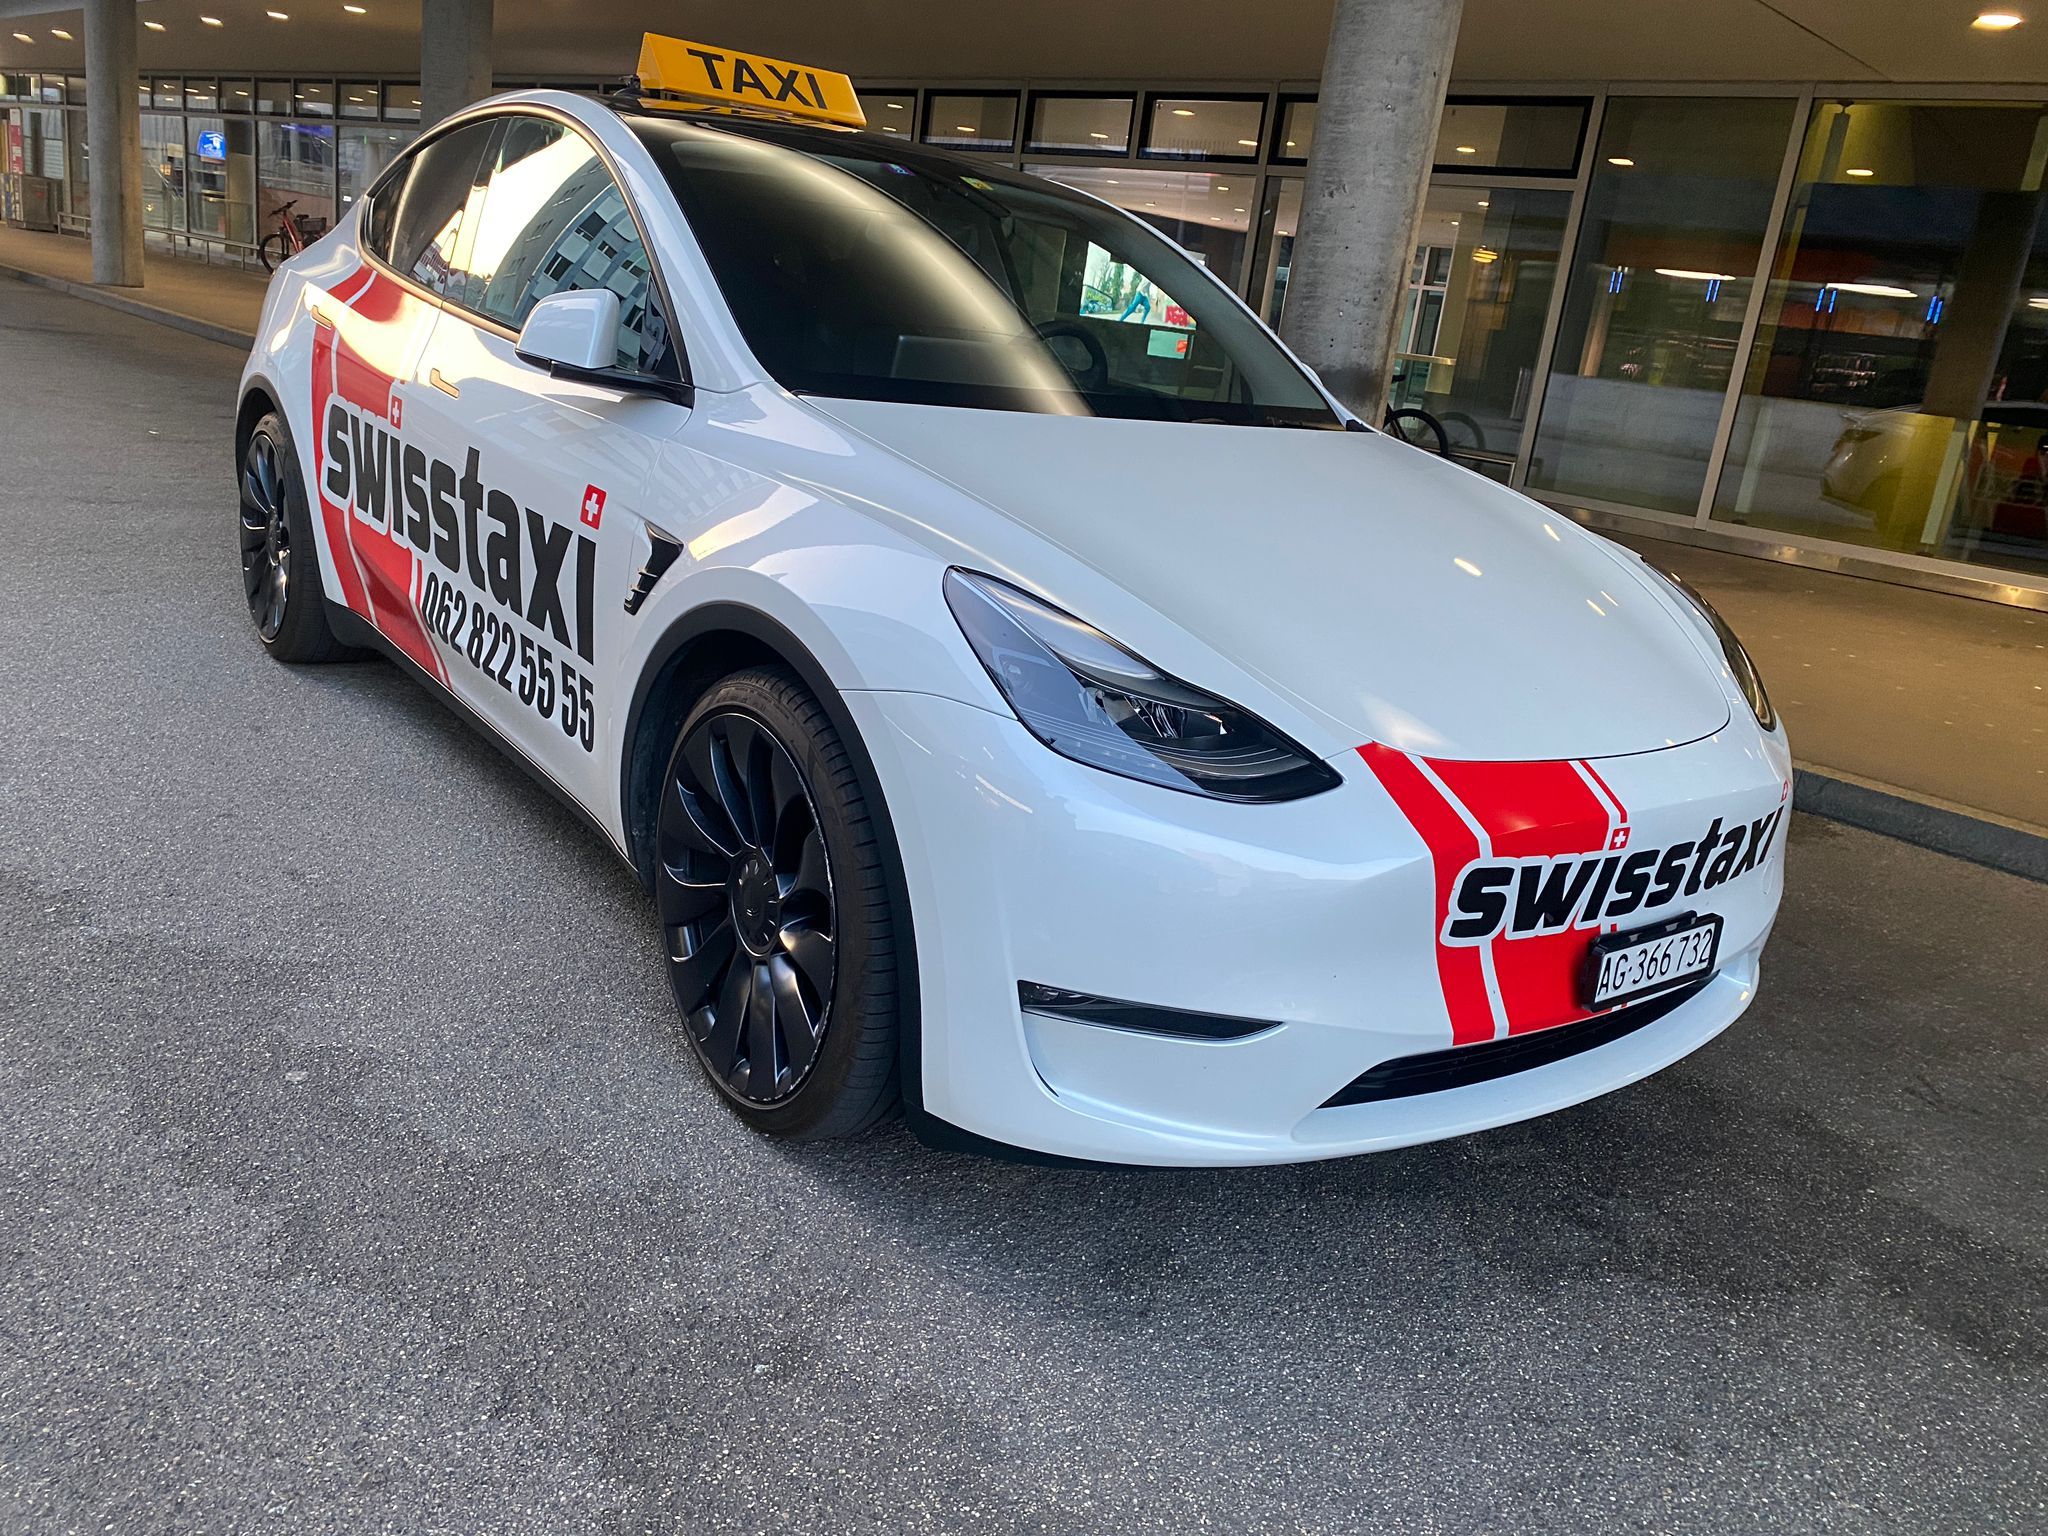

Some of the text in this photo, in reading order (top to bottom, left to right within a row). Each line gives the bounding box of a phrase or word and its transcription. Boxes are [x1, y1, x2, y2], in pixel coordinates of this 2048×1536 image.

[686, 48, 828, 110] TAXI
[327, 397, 606, 665] swisstaxi
[422, 572, 595, 752] 062 822 55 55
[1448, 782, 1787, 938] swisstaxi
